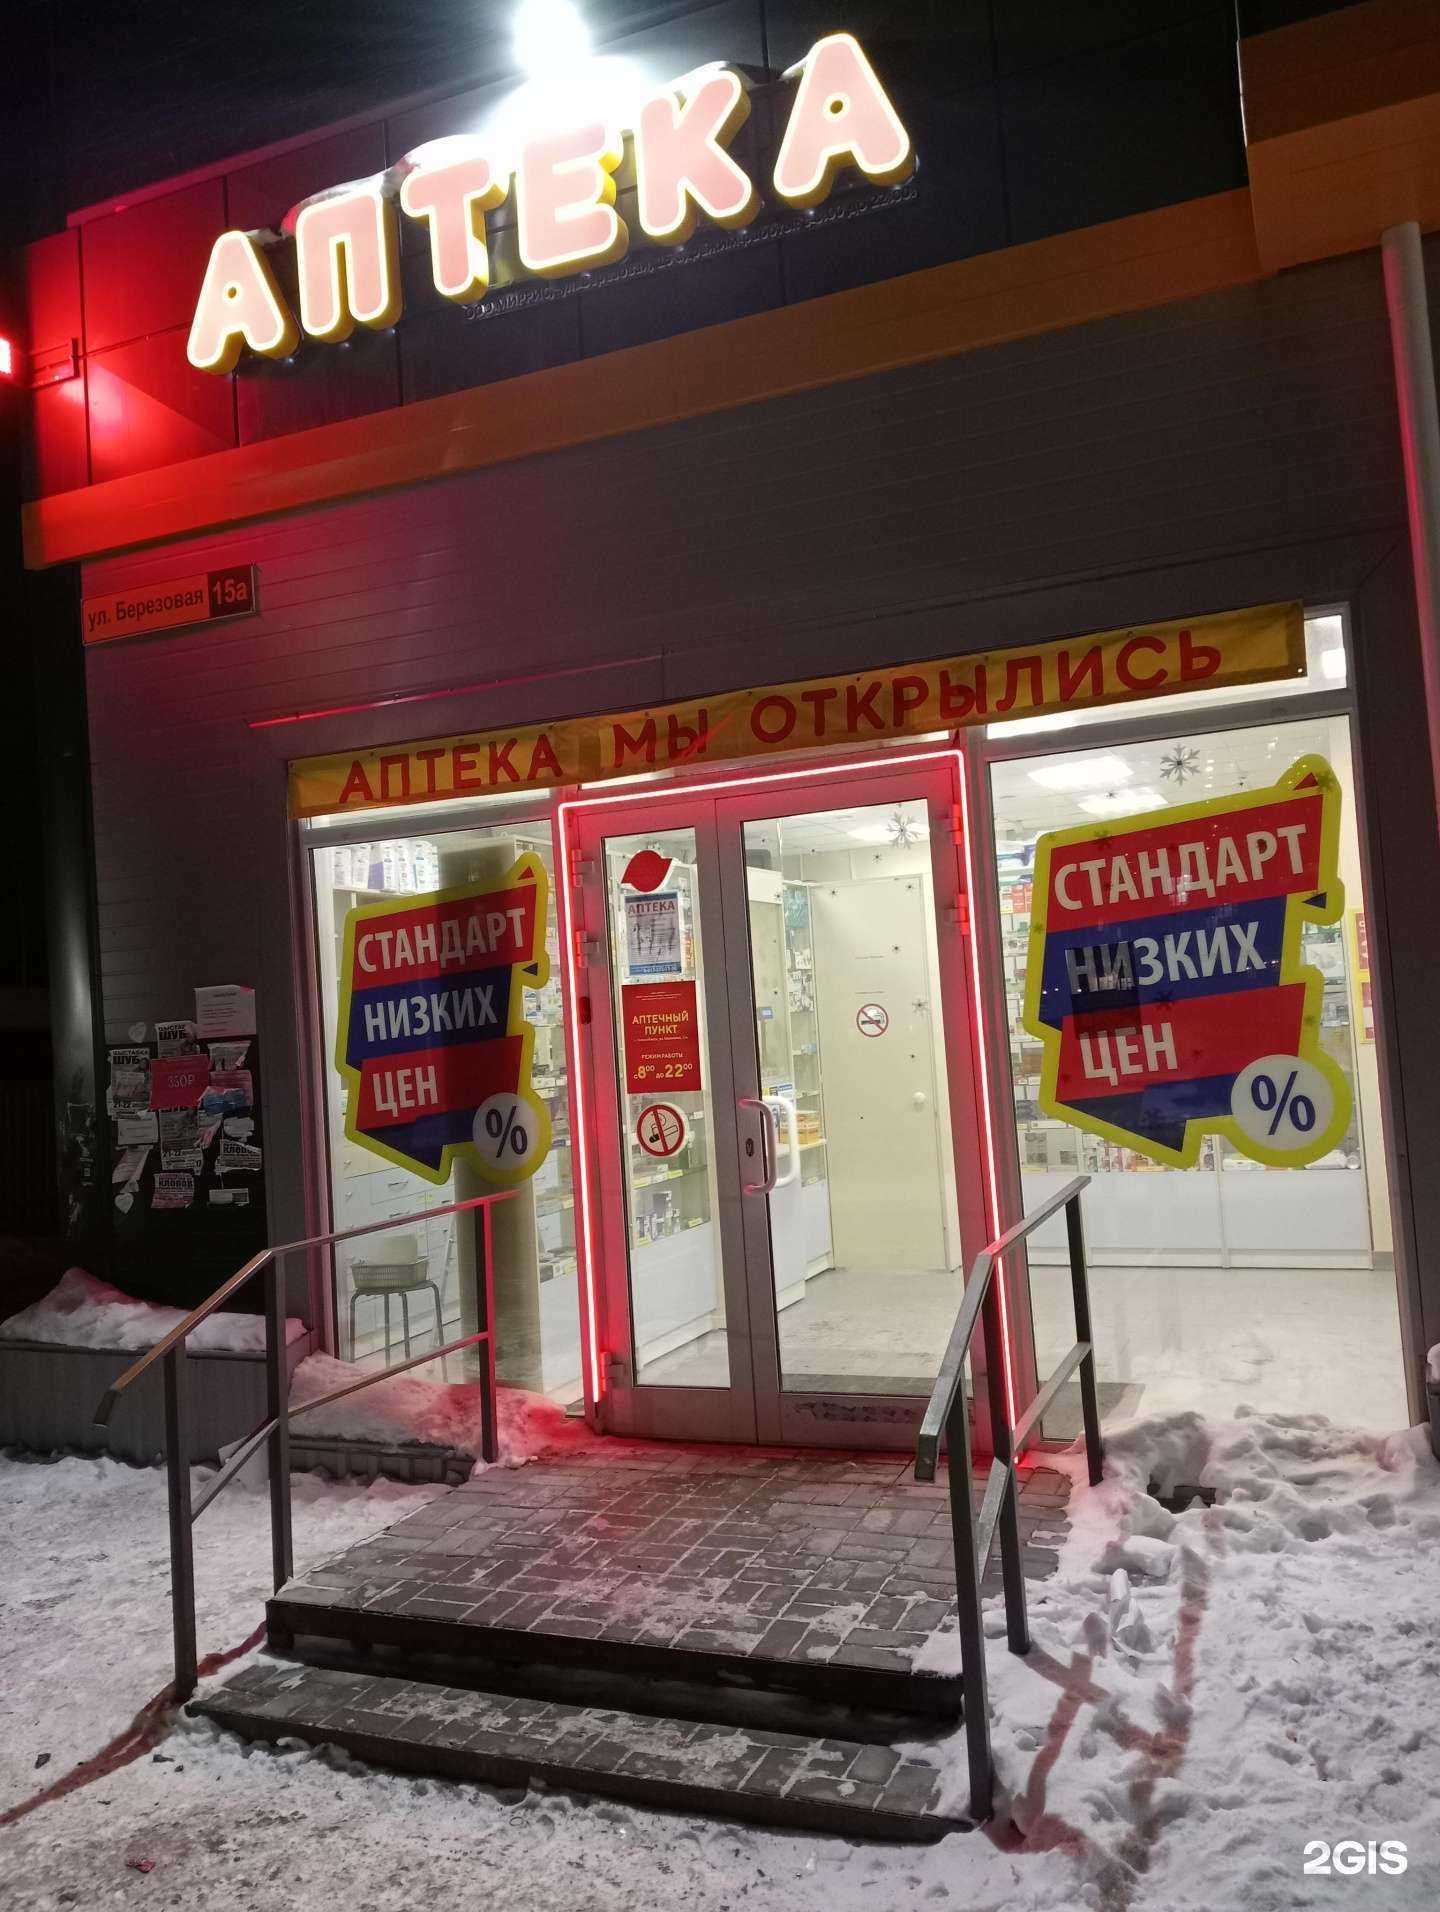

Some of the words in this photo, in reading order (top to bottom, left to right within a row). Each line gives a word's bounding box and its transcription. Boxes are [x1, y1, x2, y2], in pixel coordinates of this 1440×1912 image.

[187, 33, 911, 371] АПТЕКА
[88, 611, 111, 632] ул.
[116, 589, 204, 622] Березовая
[212, 578, 248, 606] 15а
[339, 733, 563, 805] АПТЕКА
[613, 709, 709, 768] МЫ
[750, 630, 1222, 744] ОТКРЫЛИСЬ
[1054, 823, 1307, 911] СТАНДАРТ
[628, 900, 675, 915] АПТЕКА
[357, 907, 526, 973] СТАНДАРТ
[1065, 921, 1267, 993] НИЗКИХ
[364, 984, 499, 1043] НИЗКИХ
[632, 1010, 689, 1024] АПТЕЧНЫЙ
[645, 1024, 678, 1035] ПУНКТ
[1080, 1022, 1178, 1087] ЦЕН
[372, 1065, 439, 1117] ЦЕН
[1251, 1070, 1316, 1136] %
[485, 1105, 528, 1158] %
